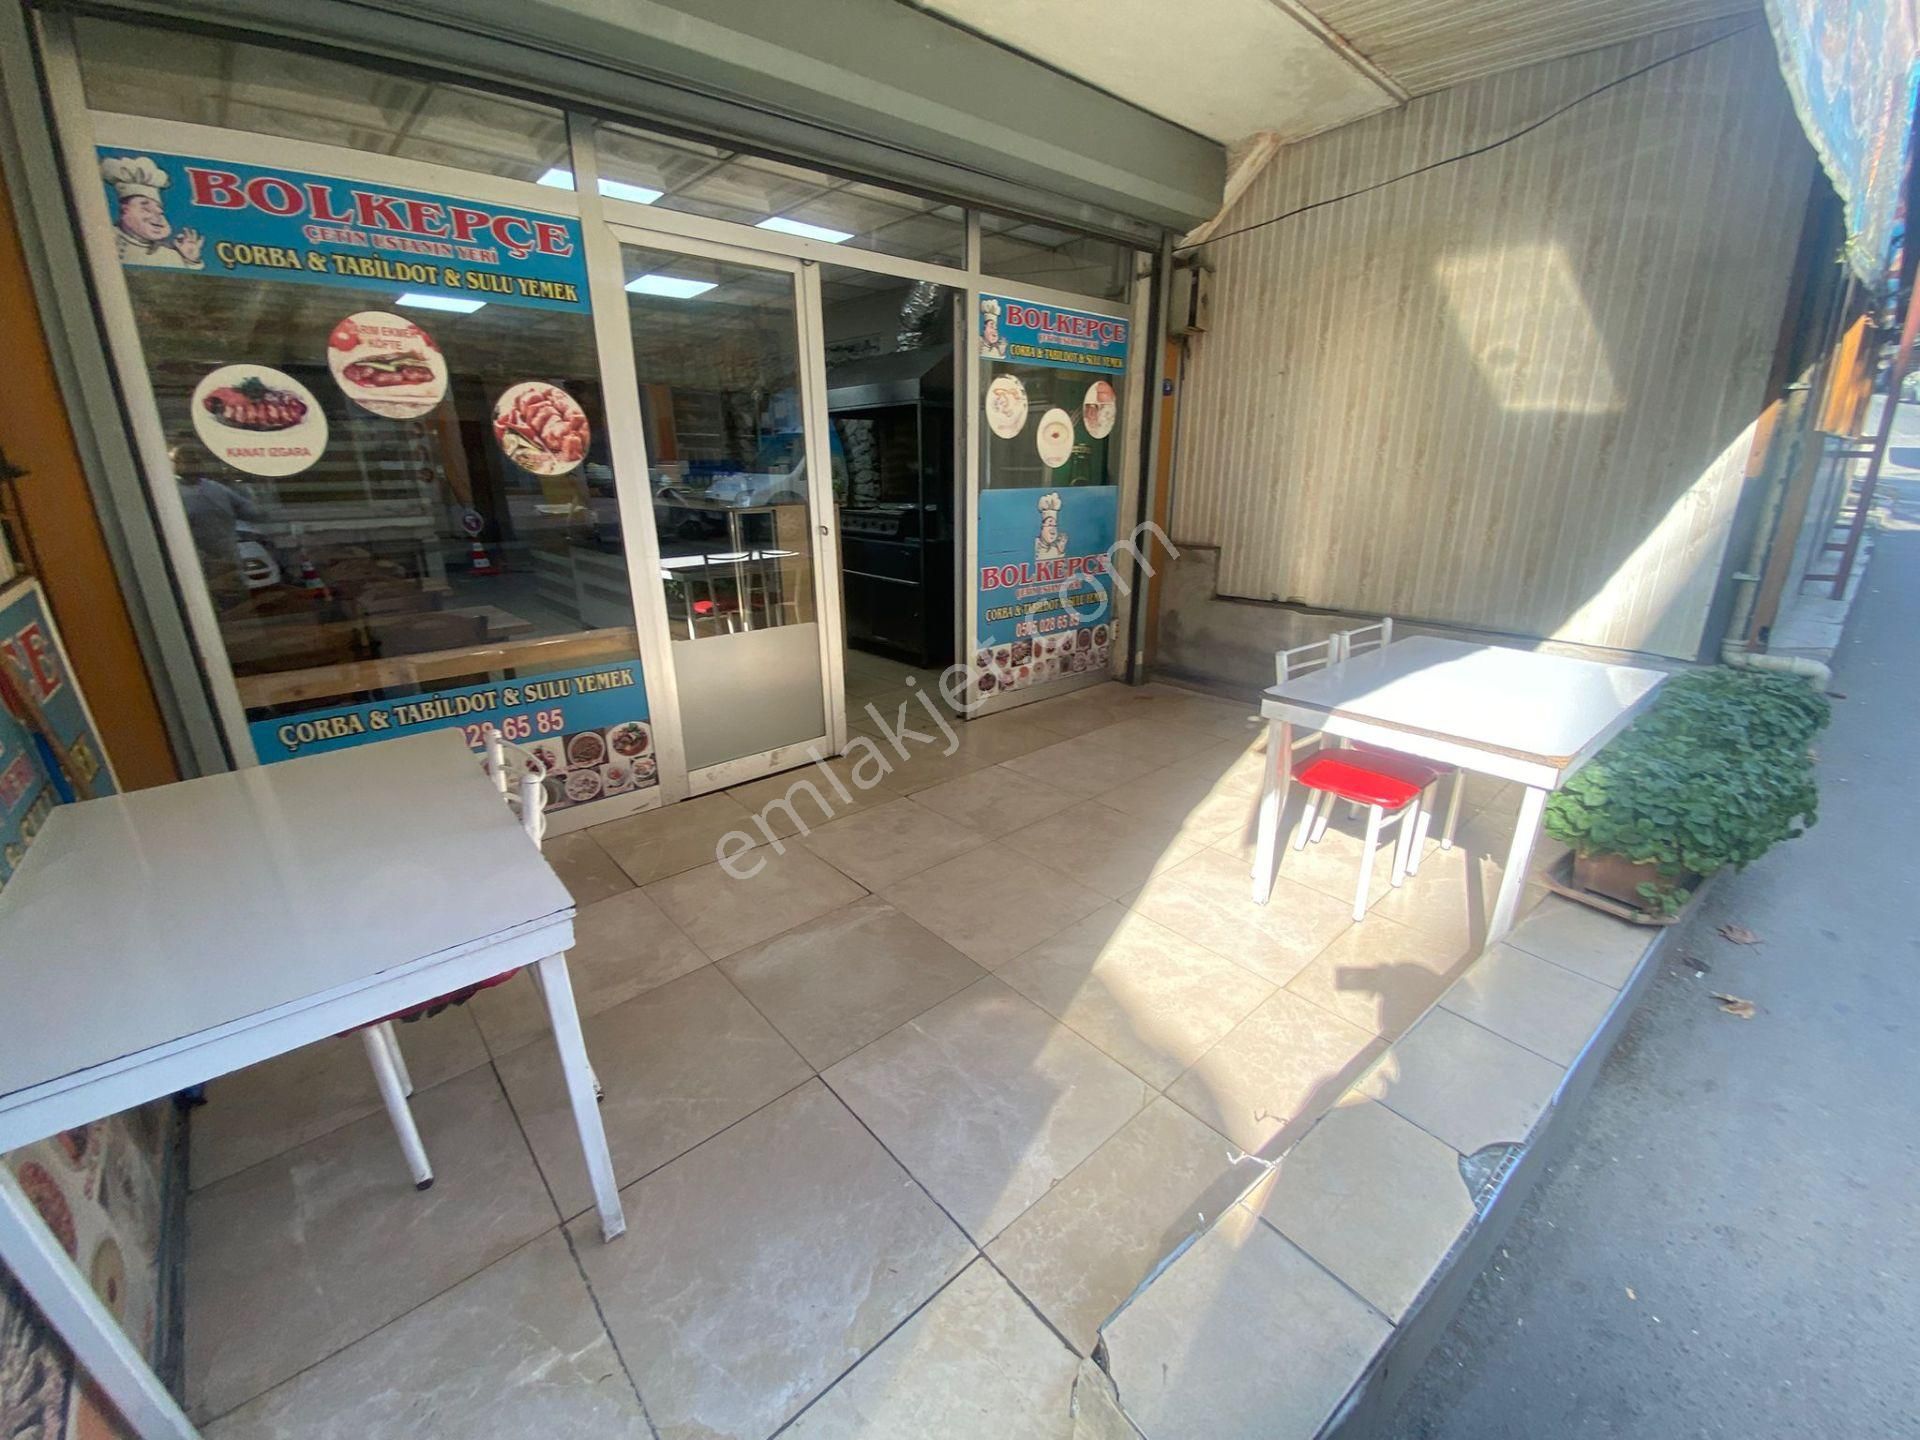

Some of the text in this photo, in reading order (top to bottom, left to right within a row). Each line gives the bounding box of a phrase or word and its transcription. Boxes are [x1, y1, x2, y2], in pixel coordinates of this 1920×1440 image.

[184, 167, 575, 261] BOLKEPÇE
[216, 242, 578, 302] ÇORBA & TABİLDOT & SULU YEMEK
[1006, 303, 1126, 347] BOLKEPÇE
[278, 668, 634, 752] ÇORBA & TABİLDOT & SULU YEMEK
[502, 715, 531, 740] 65
[536, 708, 564, 733] 85
